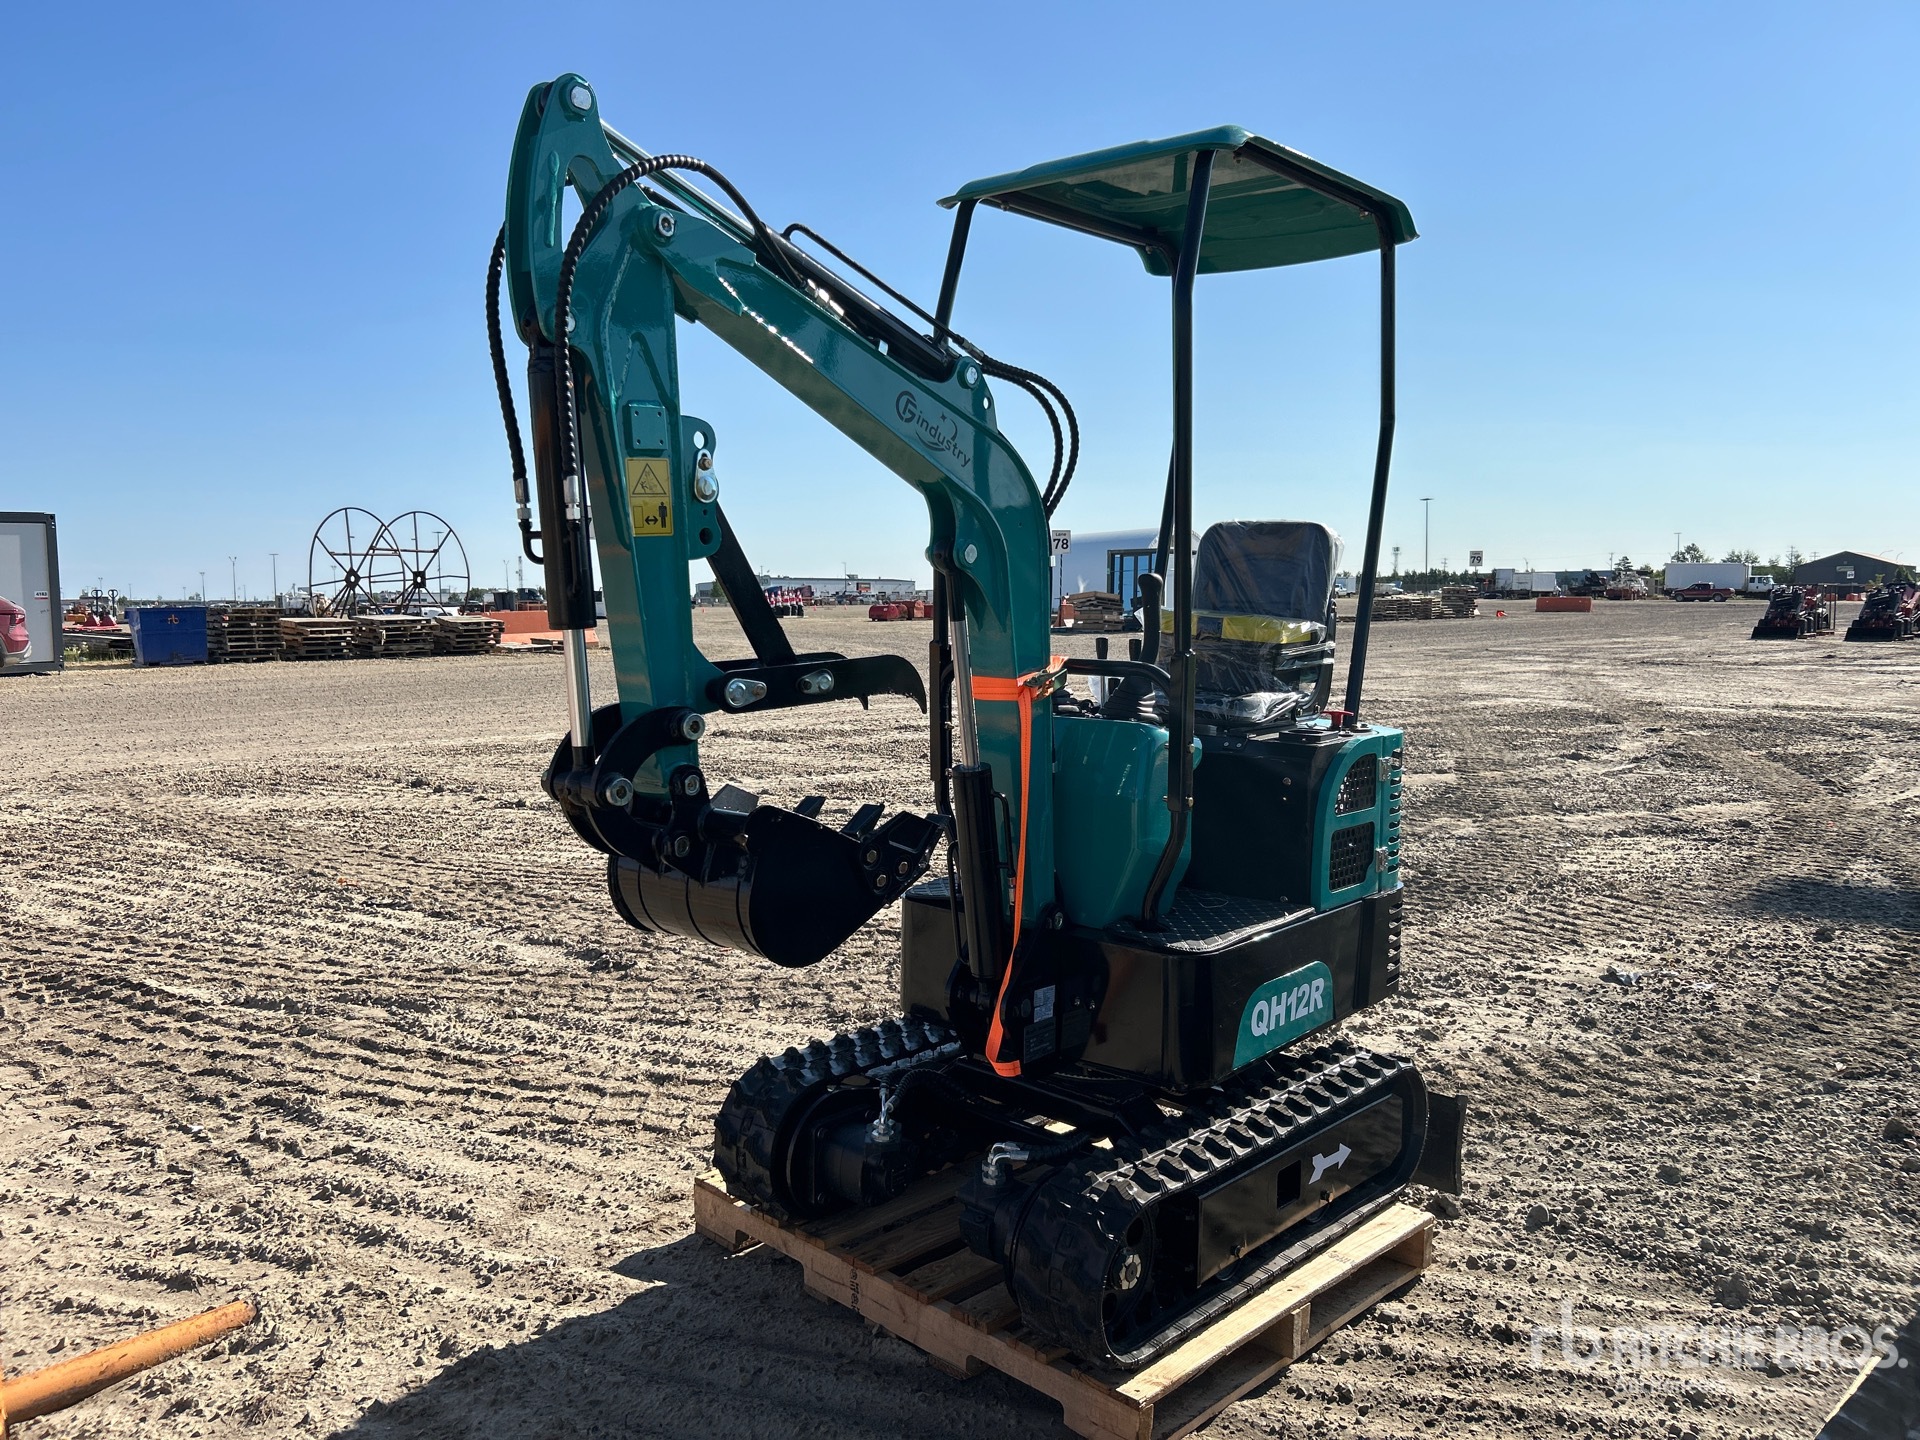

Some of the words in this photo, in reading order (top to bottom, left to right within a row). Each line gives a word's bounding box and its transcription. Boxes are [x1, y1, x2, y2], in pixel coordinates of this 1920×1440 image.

[1053, 538, 1069, 550] 78
[1470, 556, 1482, 564] 79
[1251, 977, 1325, 1037] QH12R
